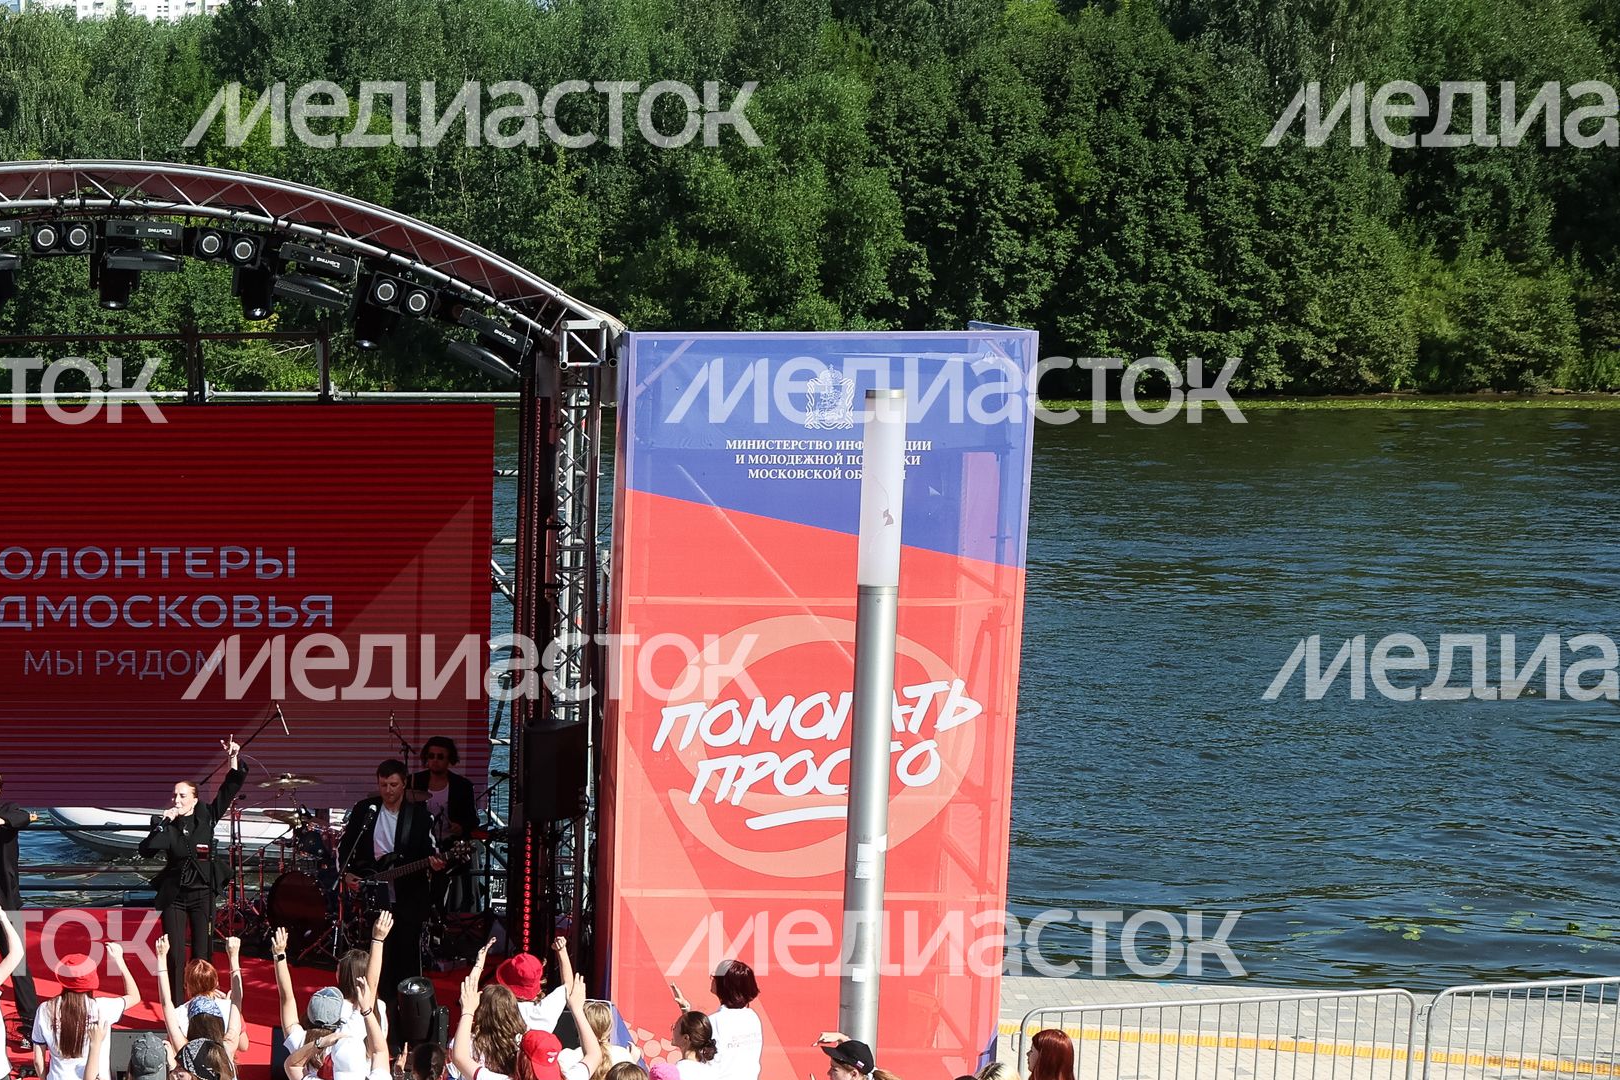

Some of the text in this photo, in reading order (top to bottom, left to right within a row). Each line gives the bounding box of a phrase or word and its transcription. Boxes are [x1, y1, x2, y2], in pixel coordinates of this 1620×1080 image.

[726, 439, 932, 452] МИНИСТЕРСТВО ИНФЦИИ
[735, 455, 745, 465] И
[748, 453, 843, 466] МОЛОДЕЖНОЙ
[748, 467, 842, 480] МОСКОВСКОЙ
[23, 650, 83, 676] МЫ
[688, 740, 942, 806] ПРОСО
